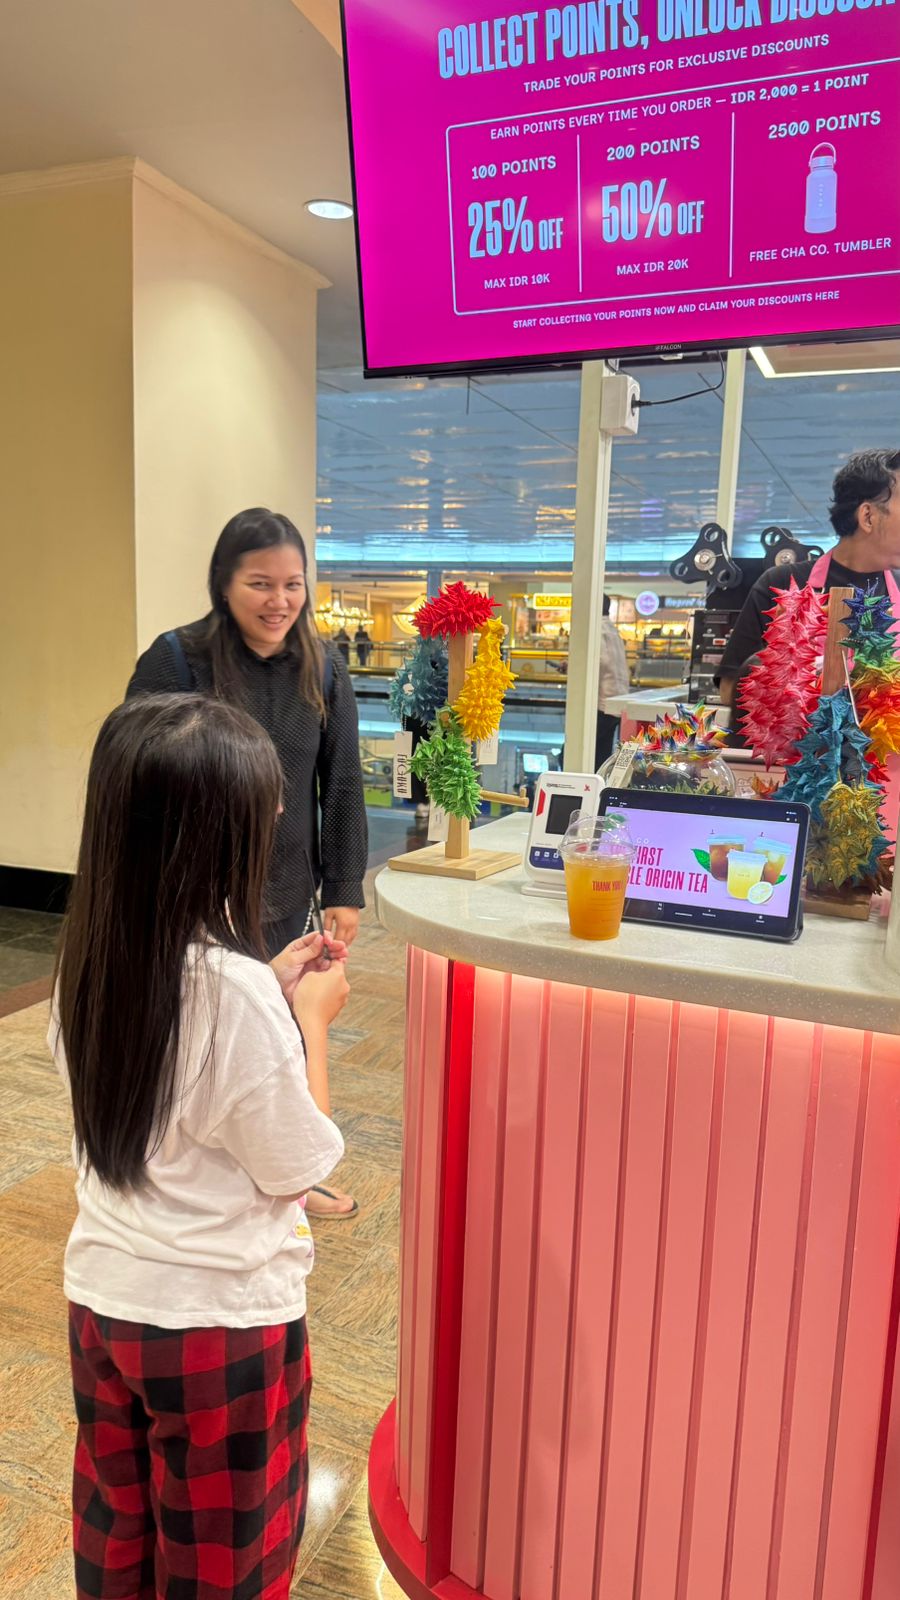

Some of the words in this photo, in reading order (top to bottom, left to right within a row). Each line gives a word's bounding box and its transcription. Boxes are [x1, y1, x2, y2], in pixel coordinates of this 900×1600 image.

[438, 12, 538, 79] COLLECT
[545, 0, 649, 61] POINTS,
[524, 77, 560, 92] TRADE
[564, 71, 596, 86] YOUR
[600, 63, 645, 80] POINTS
[649, 59, 673, 72] FOR
[678, 47, 747, 68] EXCLUSIVE
[752, 34, 829, 57] DISCOUNTS
[491, 125, 519, 140] EARN
[523, 118, 565, 134] POINTS
[569, 113, 604, 128] EVERY
[608, 107, 638, 121] TIME
[642, 103, 666, 116] YOU
[670, 97, 711, 113] ORDER
[731, 90, 755, 104] IDR
[759, 84, 798, 100] 2,000
[814, 80, 820, 92] 1
[825, 73, 869, 90] POINT
[768, 120, 810, 139] 2500
[816, 110, 881, 132] POINTS
[607, 144, 635, 161] 200
[641, 135, 700, 156] POINTS
[472, 164, 497, 179] 100
[502, 155, 556, 175] POINTS
[602, 179, 673, 243] 50%
[677, 200, 704, 235] OFF
[468, 196, 534, 258] 25%
[538, 217, 564, 251] OFF
[750, 249, 777, 261] FREE
[781, 247, 806, 258] CHA
[810, 244, 829, 256] CO.
[834, 237, 891, 253] TUMBLER
[484, 278, 506, 289] MAX
[509, 276, 528, 286] IDR
[532, 273, 550, 284] 10K
[617, 264, 640, 275] MAX
[644, 261, 664, 272] IDR
[668, 259, 688, 270] 20K
[513, 319, 537, 328] START
[539, 314, 591, 326] COLLECTING
[594, 311, 616, 320] YOUR
[619, 308, 651, 318] POINTS
[654, 306, 675, 315] NOW
[678, 304, 696, 313] AND
[698, 301, 728, 311] CLAIM
[731, 298, 755, 308] YOUR
[758, 293, 812, 306] DISCOUNTS
[815, 291, 839, 300] HERE
[645, 867, 685, 890] ORIGIN
[688, 872, 708, 893] TEA
